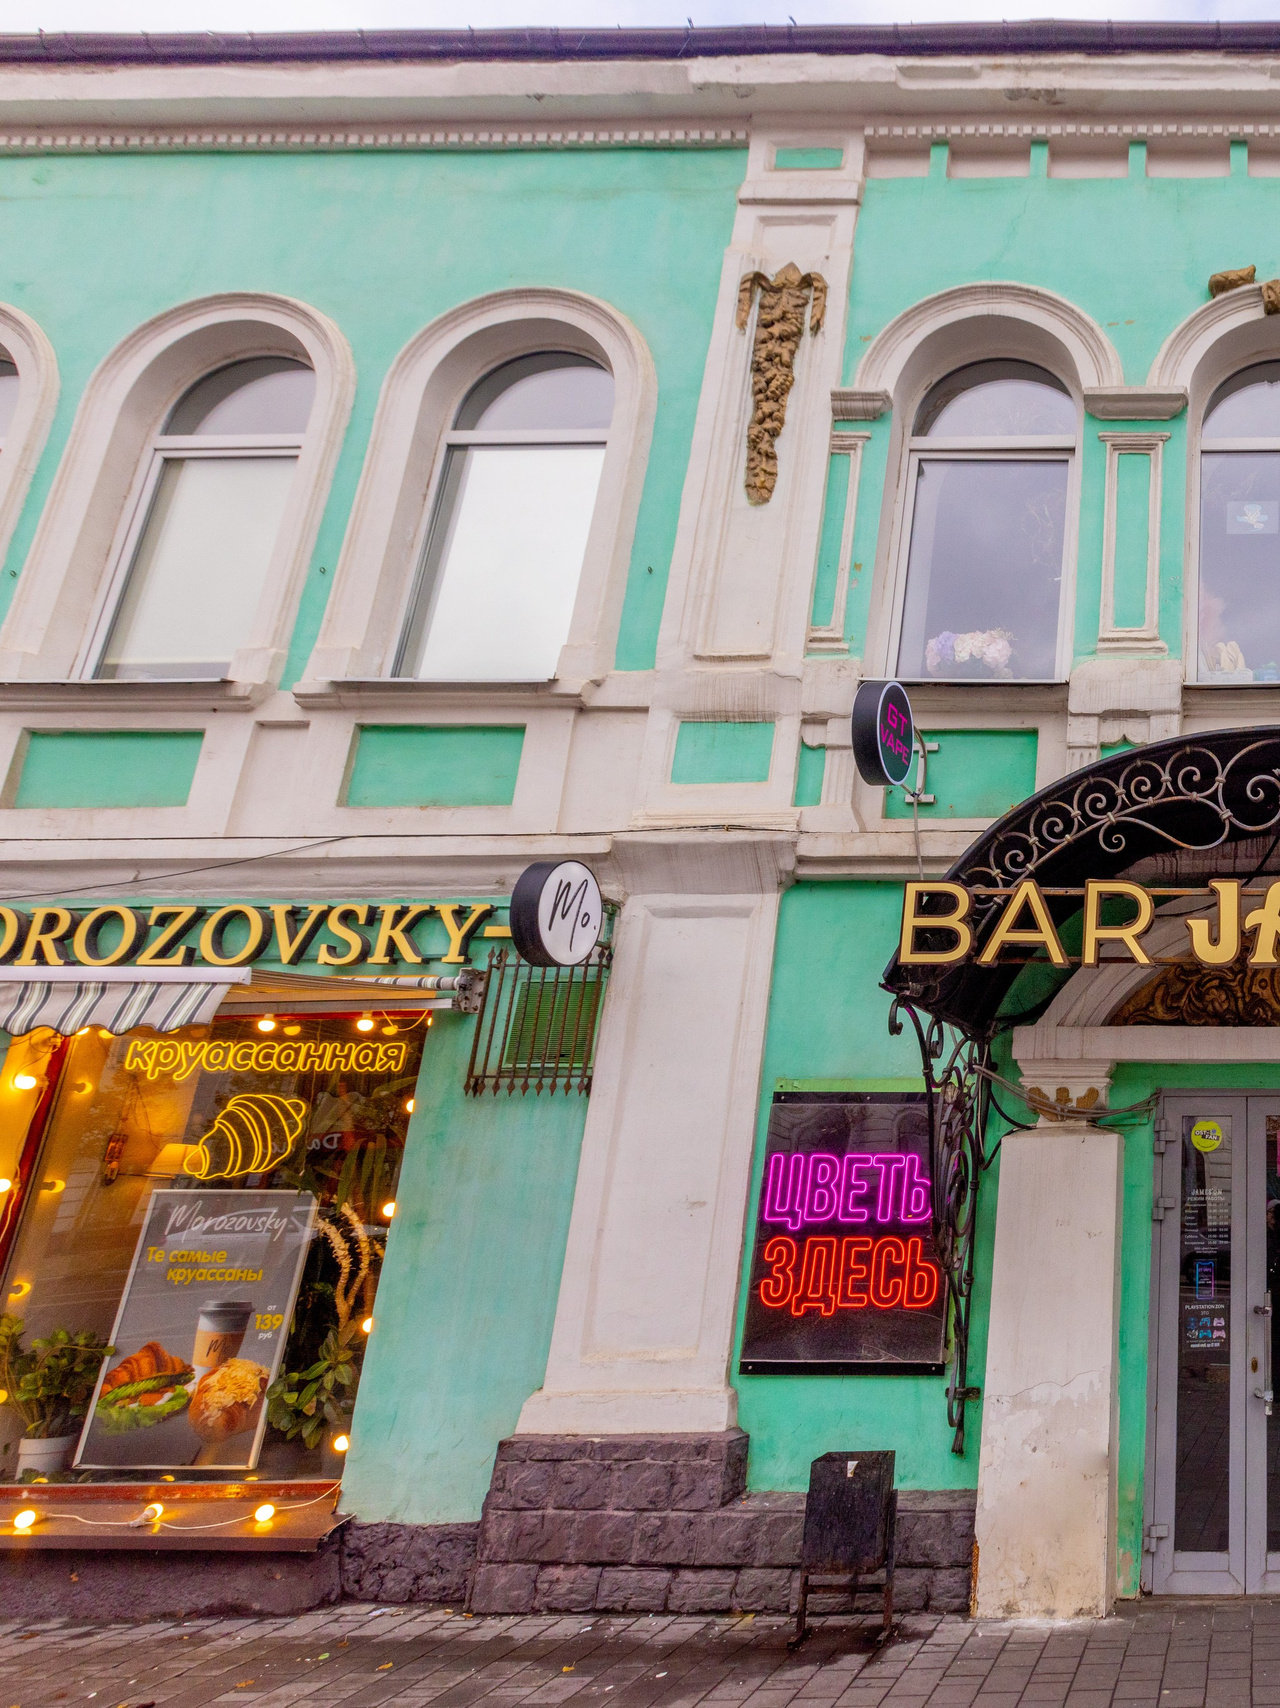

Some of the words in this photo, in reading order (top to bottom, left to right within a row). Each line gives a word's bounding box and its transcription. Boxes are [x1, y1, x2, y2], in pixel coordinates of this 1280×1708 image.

[887, 702, 908, 736] GT
[880, 722, 910, 766] VAPE
[0, 904, 511, 966] ROZOVSKY-
[899, 880, 1156, 967] BAR
[124, 1040, 406, 1081] круассанная
[147, 1246, 165, 1263] Те
[169, 1249, 228, 1263] самые
[167, 1268, 264, 1285] круассаны
[760, 1236, 938, 1316] ЗДЕСЬ
[255, 1313, 284, 1331] 139
[258, 1331, 273, 1340] руб
